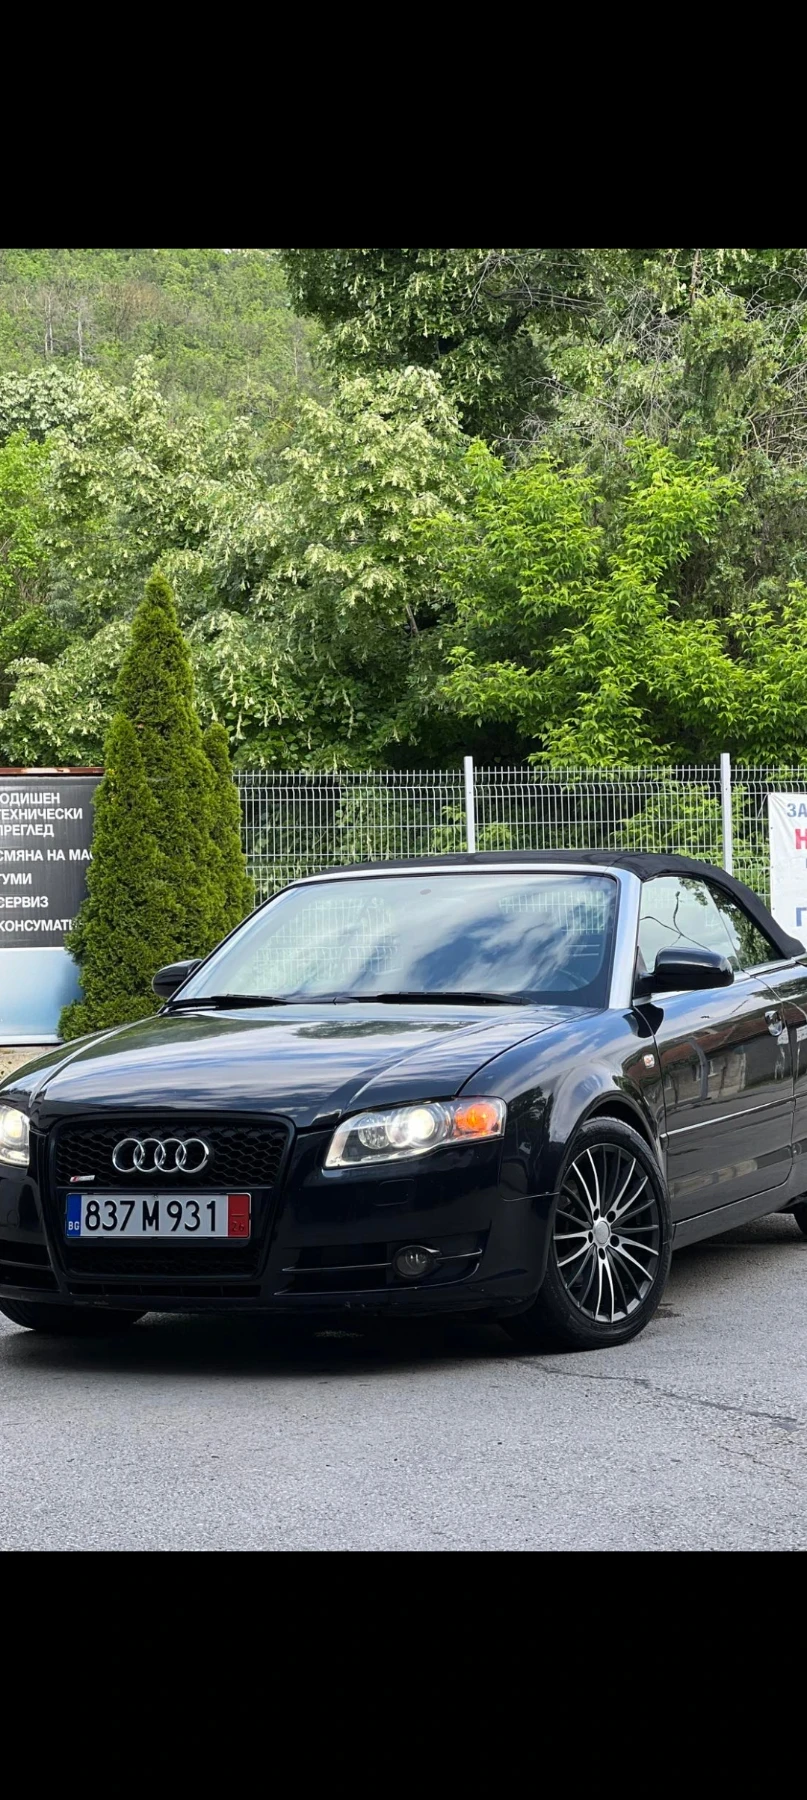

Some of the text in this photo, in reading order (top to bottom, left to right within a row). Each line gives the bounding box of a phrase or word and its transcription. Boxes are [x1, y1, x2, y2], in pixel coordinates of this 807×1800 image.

[0, 808, 83, 820] ЕХНИЧЕСКИ
[47, 849, 66, 861] НА
[0, 873, 32, 885] УМИ
[85, 1200, 216, 1231] 837 M 931
[68, 1221, 80, 1231] BG
